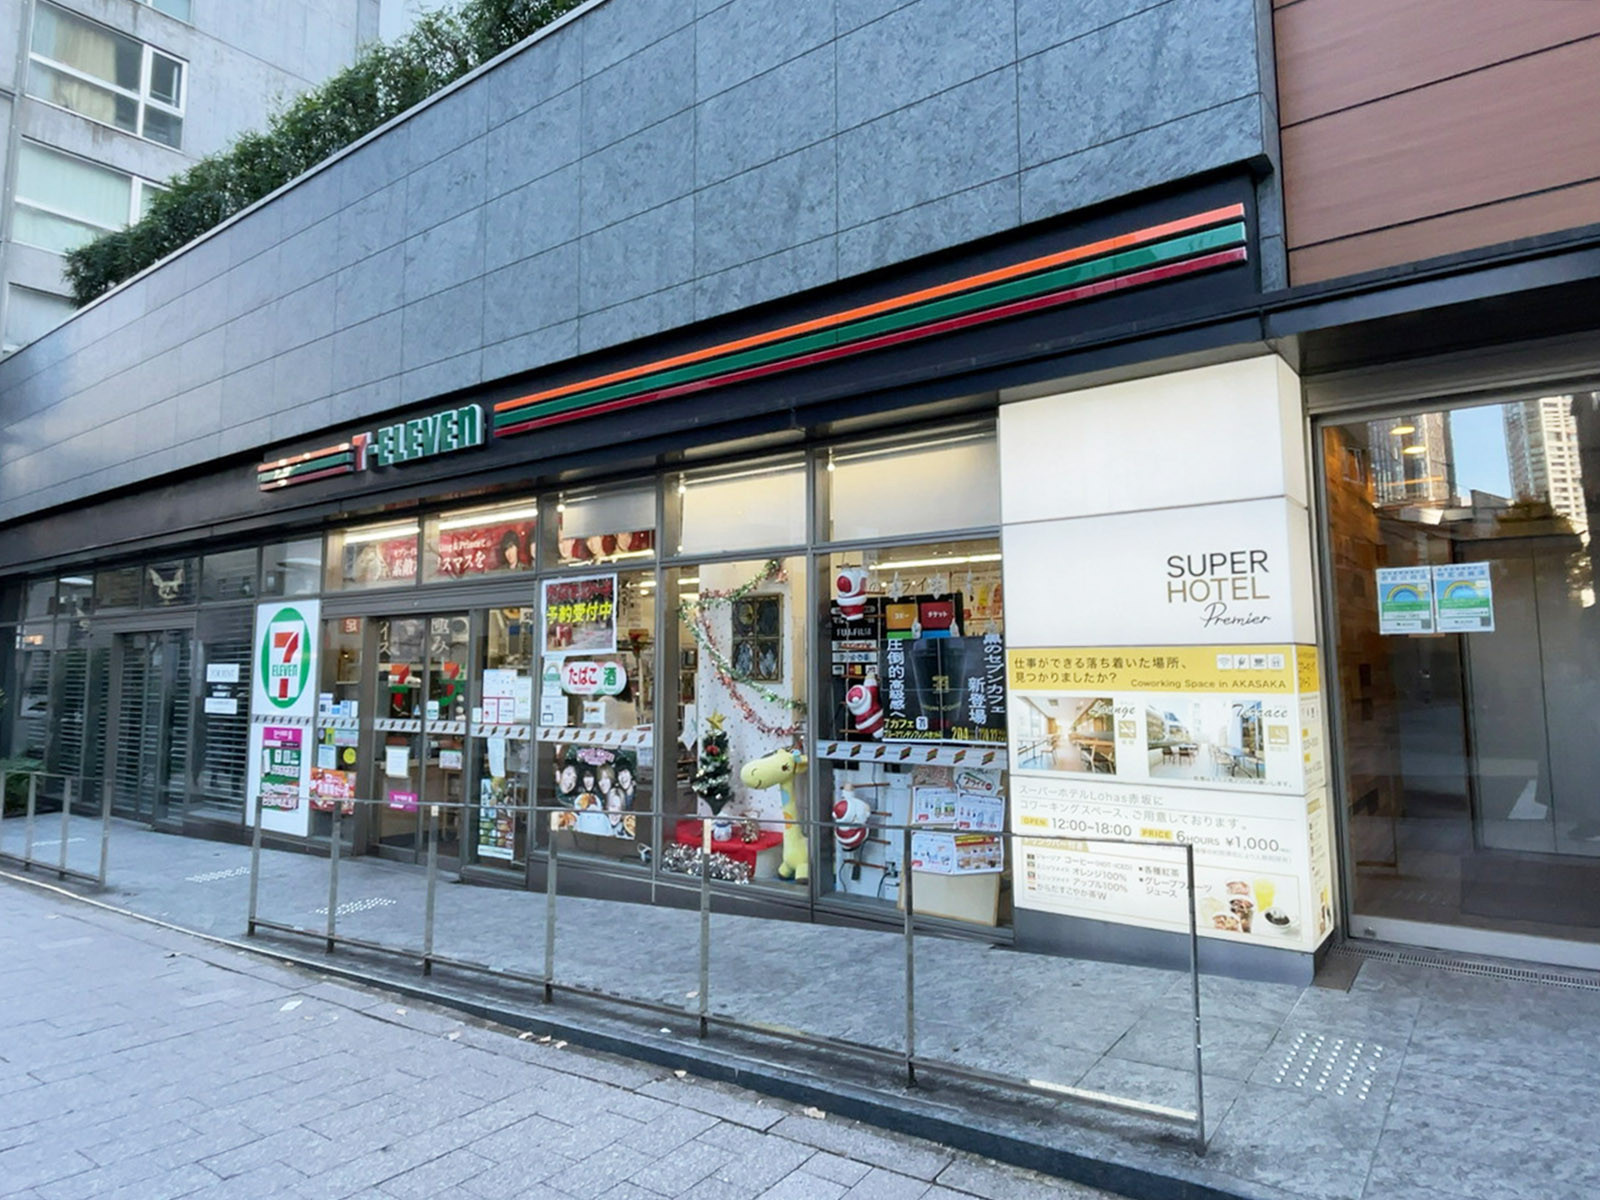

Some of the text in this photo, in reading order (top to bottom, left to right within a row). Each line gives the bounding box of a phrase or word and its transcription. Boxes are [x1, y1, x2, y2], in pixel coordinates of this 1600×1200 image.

[1167, 549, 1270, 579] SUPER
[1167, 576, 1271, 603] HOTEL
[546, 600, 613, 625] 予約受付中
[1199, 601, 1271, 629] Premier
[1014, 656, 1187, 670] 仕事ができる落ち着いた場所、
[568, 666, 617, 686] たばこ 酒
[1015, 671, 1117, 684] 見つかりましたか?
[1130, 678, 1287, 689] Coworking Space in AKASAKA
[967, 676, 987, 725] 新登場
[1023, 816, 1047, 826] OPEN
[1141, 829, 1171, 839] PRICE
[1226, 836, 1279, 852] ¥1,000
[1145, 876, 1213, 893] グレープフーツ
[1146, 886, 1178, 898] ジュース
